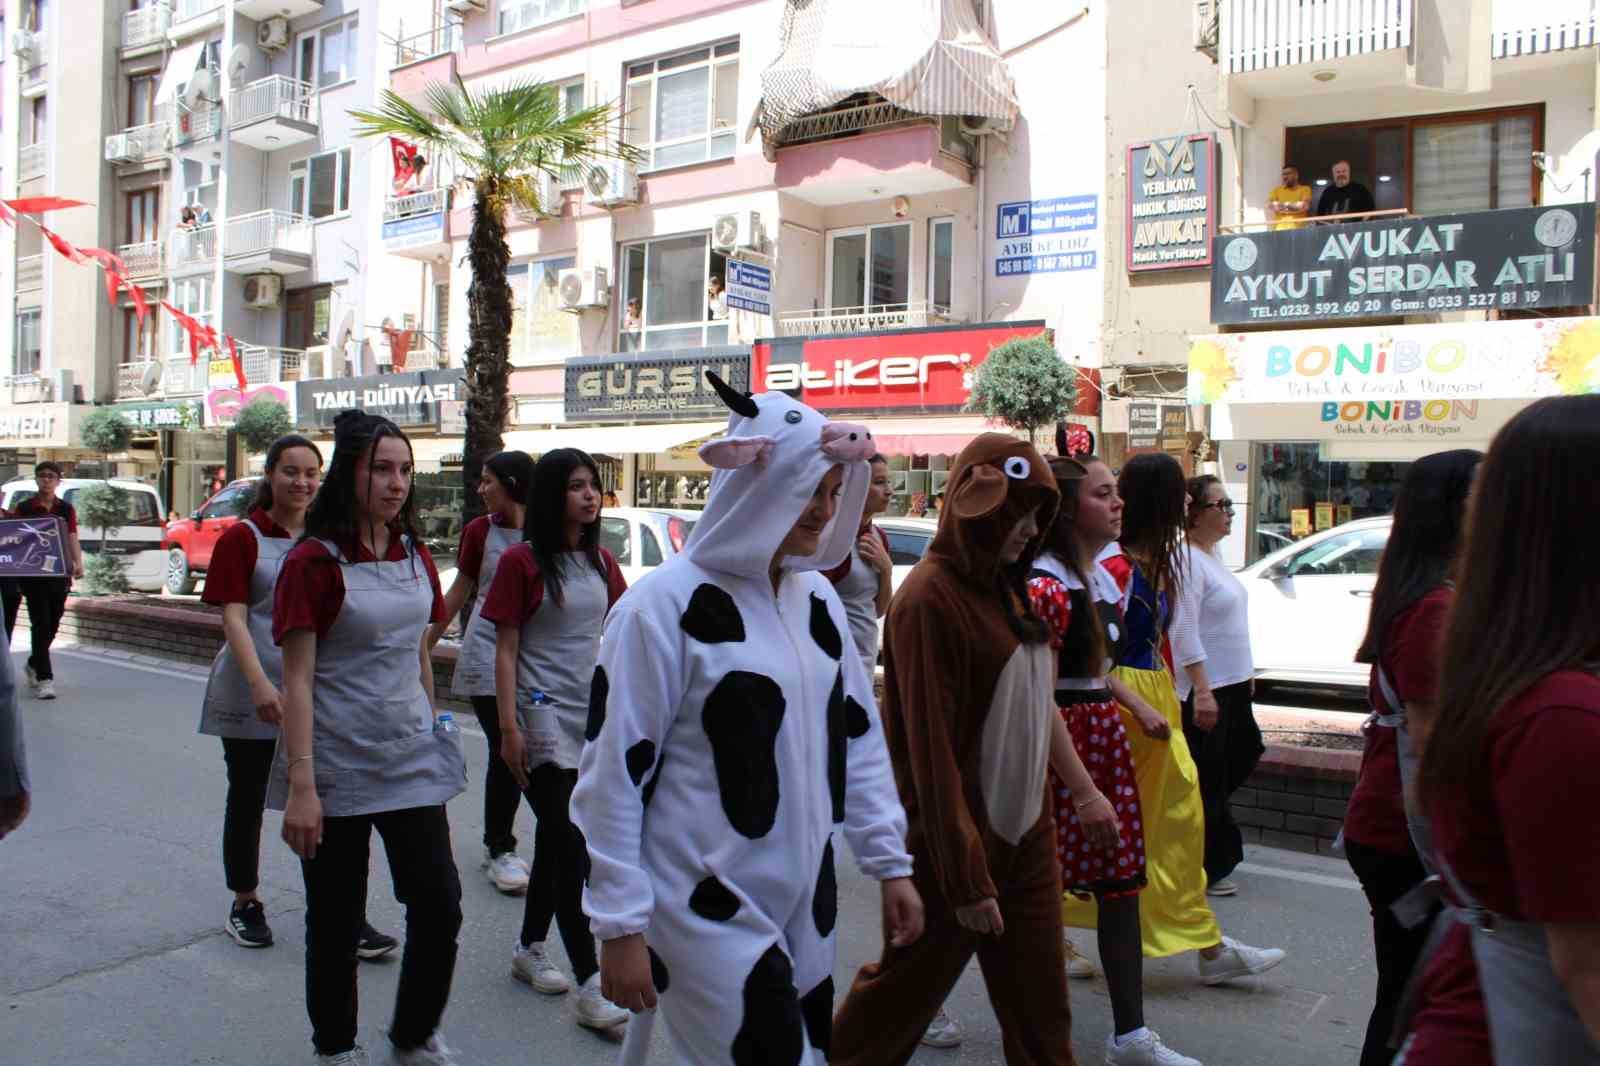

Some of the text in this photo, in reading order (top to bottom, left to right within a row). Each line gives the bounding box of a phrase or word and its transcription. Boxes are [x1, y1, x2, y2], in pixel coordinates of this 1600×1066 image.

[1142, 178, 1197, 196] YERLİKAYA
[1133, 200, 1166, 217] HUKUK
[1135, 218, 1207, 248] AVUKAT
[1318, 223, 1464, 261] AVUKAT
[1224, 252, 1575, 302] AYKUT SERDAR ATLI
[1251, 290, 1541, 318] TEL: 0232 592 60 20 Gsm: 0533 527 81 19
[576, 363, 731, 397] GÜRSU
[764, 354, 961, 391] atiker
